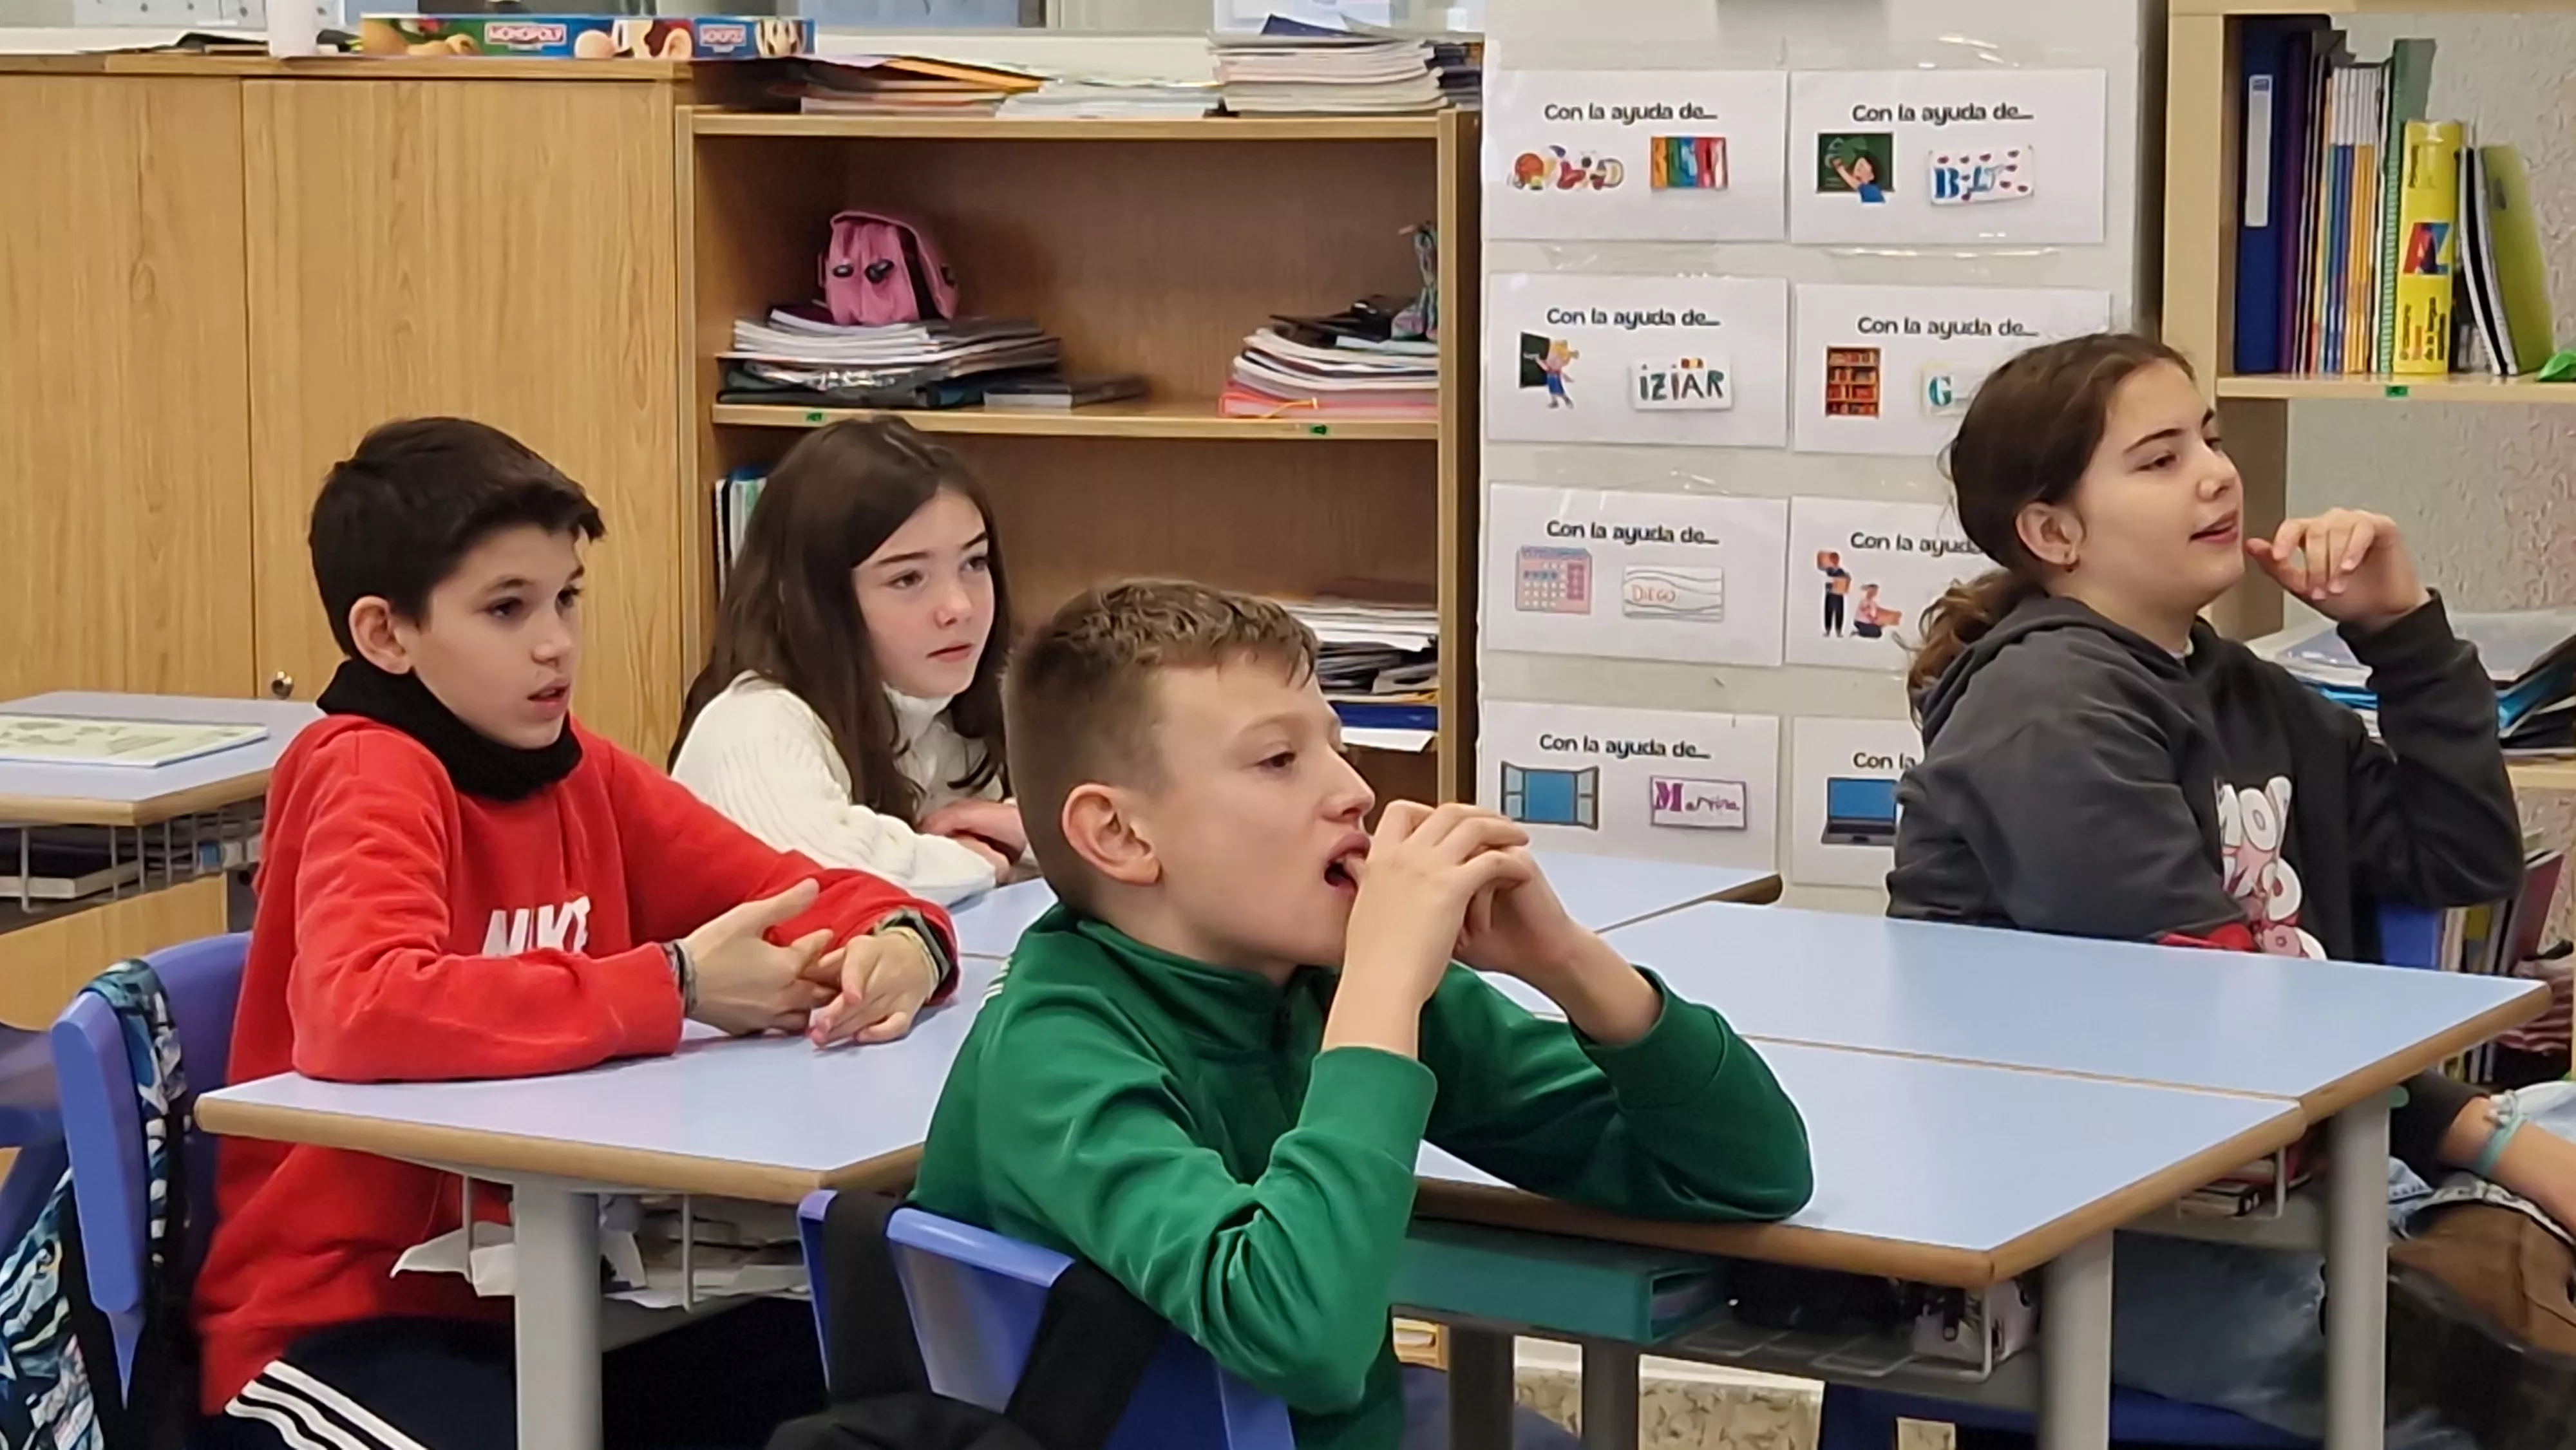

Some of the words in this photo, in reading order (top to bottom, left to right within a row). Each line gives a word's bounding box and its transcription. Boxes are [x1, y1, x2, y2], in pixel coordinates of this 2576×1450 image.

[1544, 104, 1583, 120] Con
[1589, 103, 1605, 120] la
[1611, 102, 1673, 126] ayuda
[1852, 104, 1892, 122] Con
[1899, 103, 1915, 122] la
[1922, 103, 1987, 127] ayuda
[1547, 308, 1586, 325] Con
[1591, 308, 1607, 325] la
[1614, 308, 1676, 330] ayuda
[1858, 316, 1899, 334] Con
[1904, 316, 1921, 334] la
[1927, 317, 1992, 341] ayuda
[1547, 520, 1585, 539] Con
[1591, 521, 1607, 539] la
[1613, 524, 1674, 546] ayuda
[1850, 531, 1890, 550] Con
[1896, 533, 1913, 551] la
[1540, 733, 1578, 752] Con
[1584, 735, 1600, 753] la
[1605, 738, 1667, 760] ayuda
[1853, 752, 1893, 769] Con
